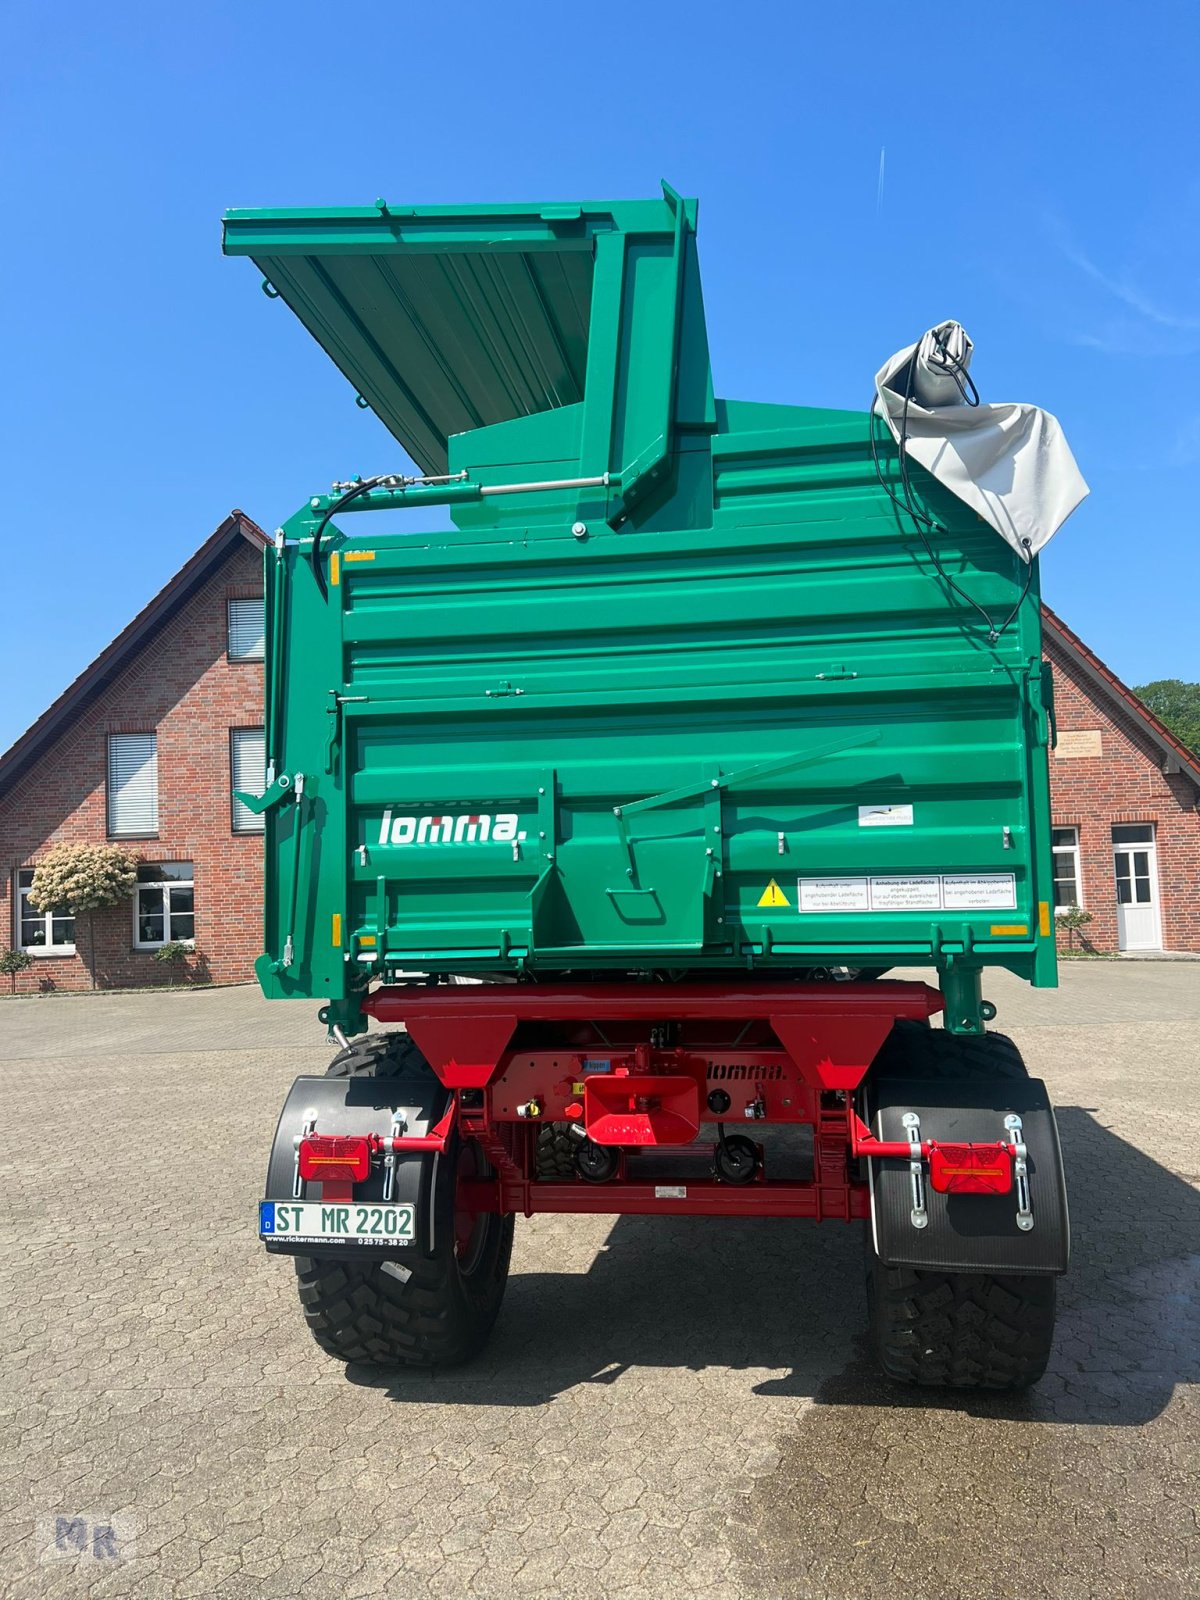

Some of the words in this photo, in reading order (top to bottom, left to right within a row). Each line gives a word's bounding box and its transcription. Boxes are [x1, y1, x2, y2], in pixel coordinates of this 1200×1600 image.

[265, 1221, 271, 1229] D
[276, 1206, 304, 1232] ST
[321, 1207, 350, 1233] MR
[356, 1208, 411, 1235] 2202
[266, 1235, 345, 1244] www.rickermann.com
